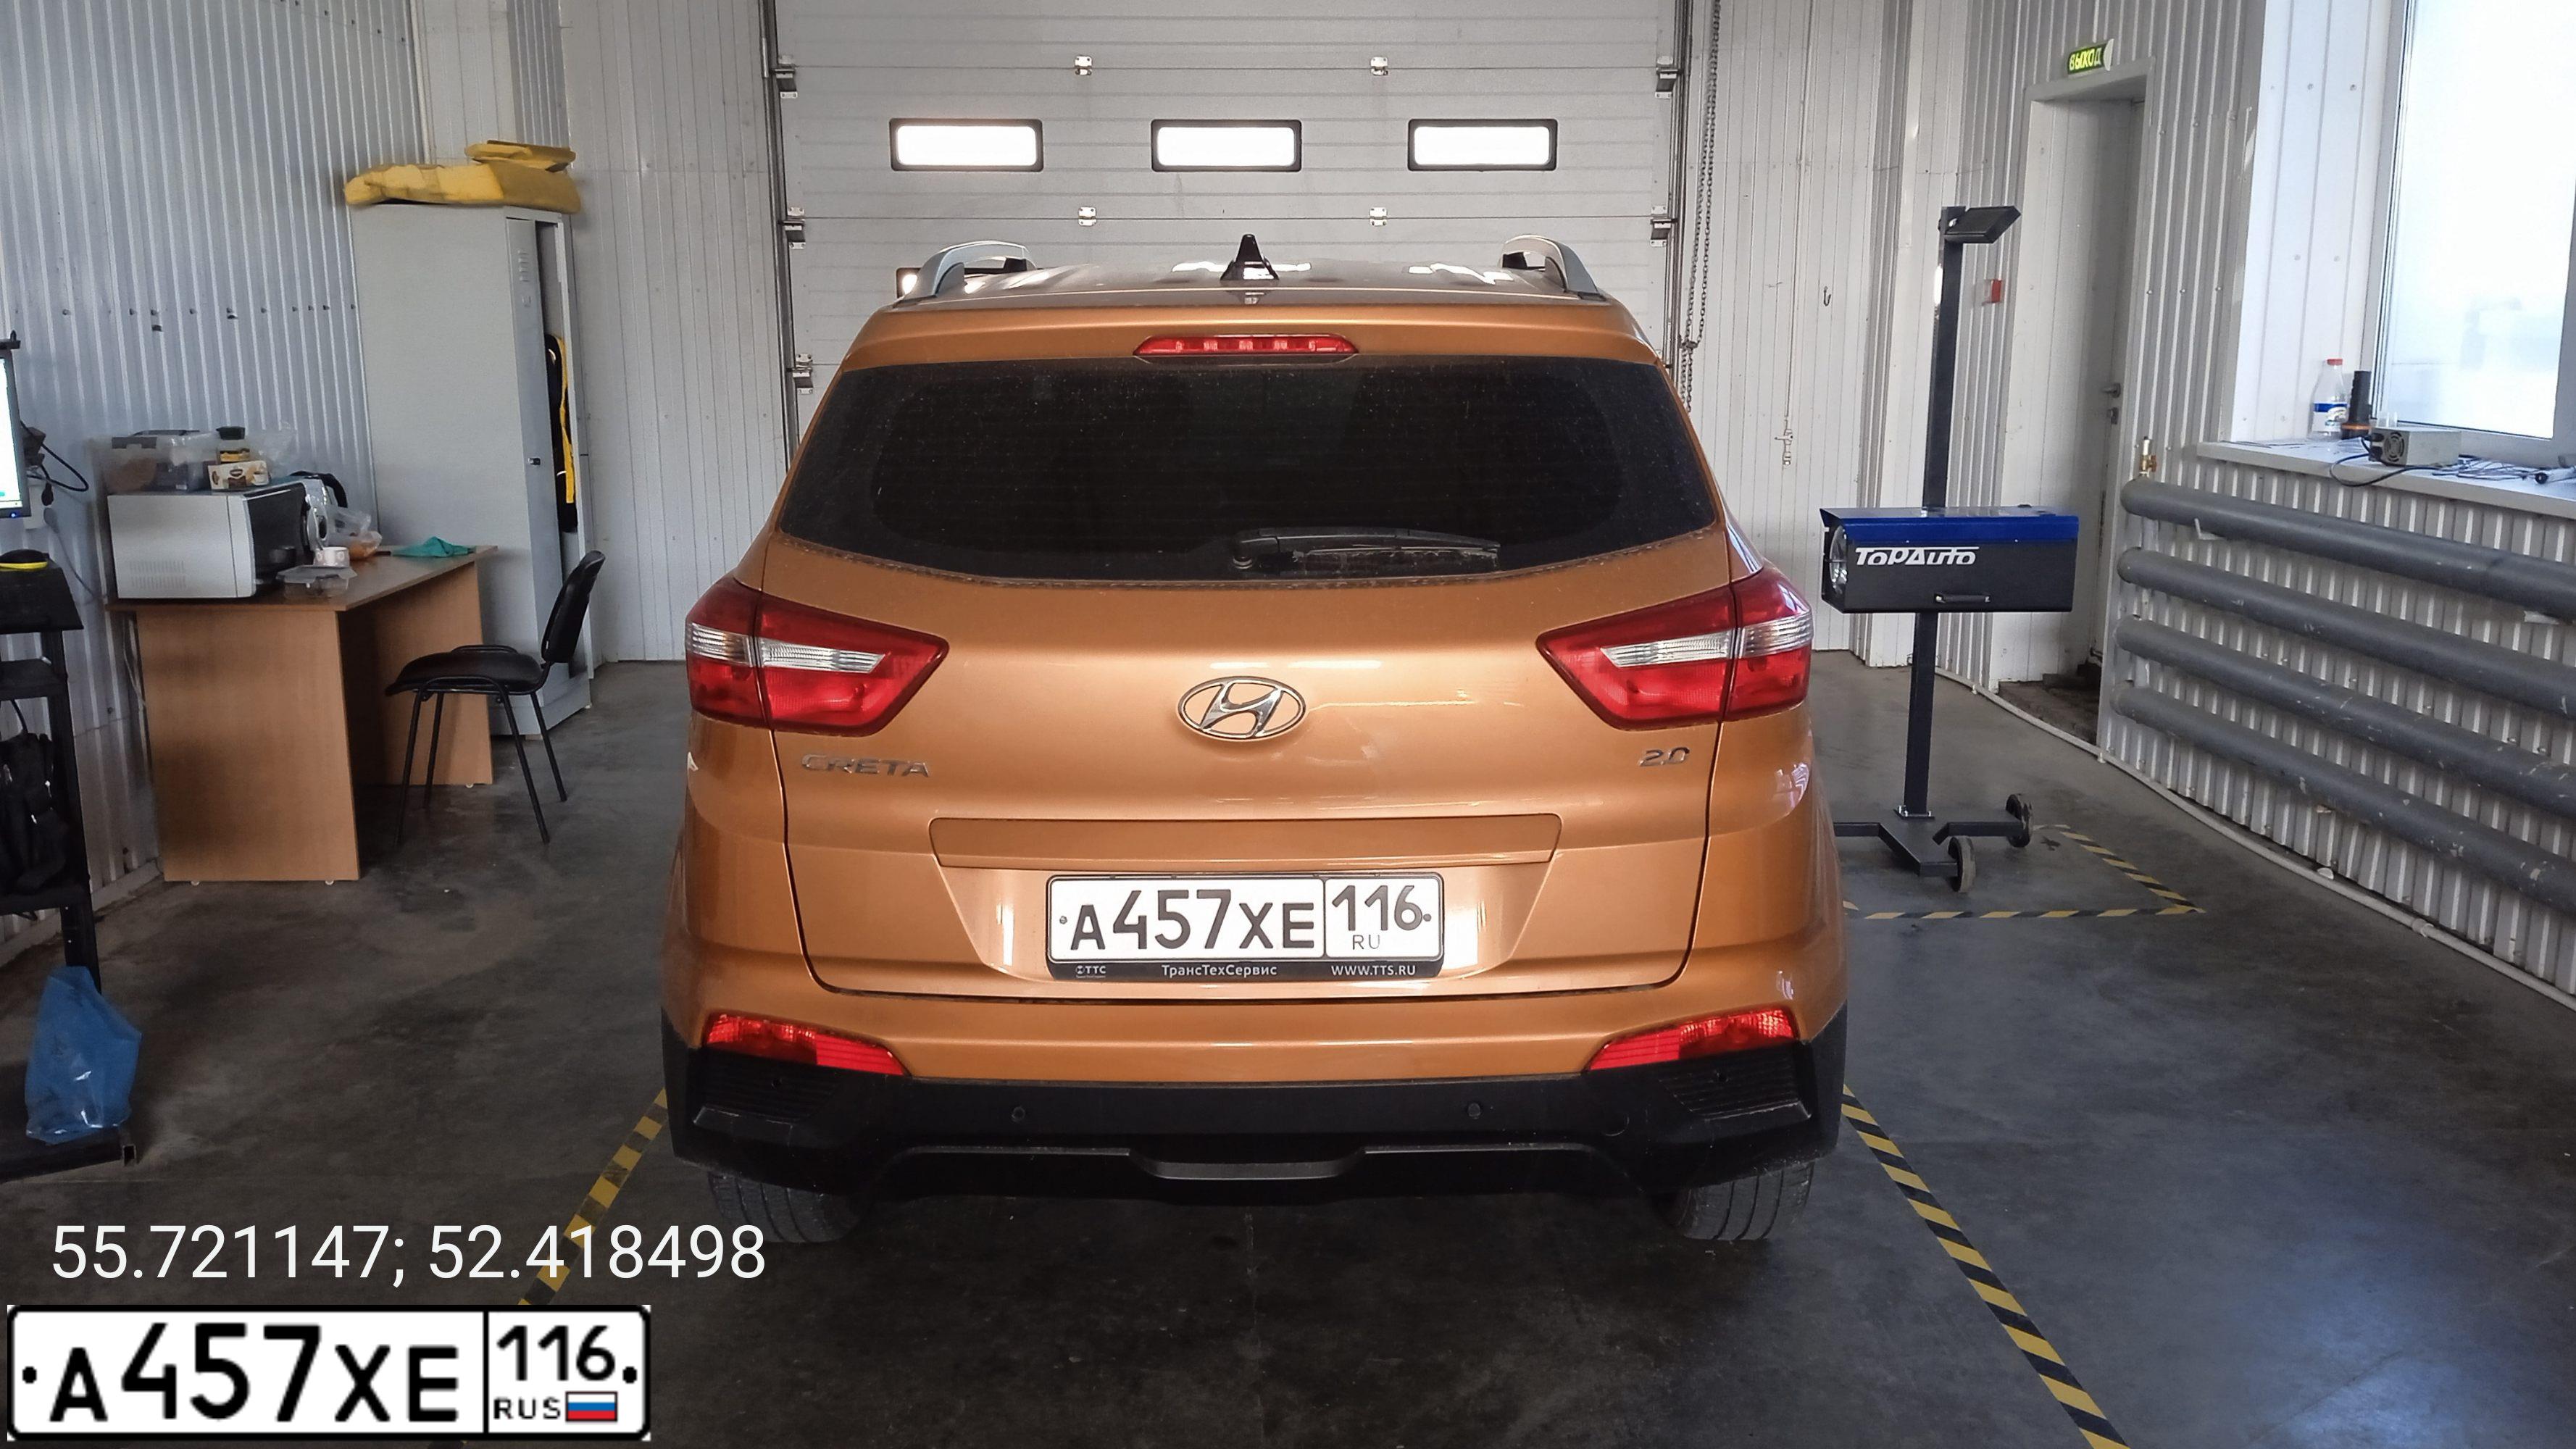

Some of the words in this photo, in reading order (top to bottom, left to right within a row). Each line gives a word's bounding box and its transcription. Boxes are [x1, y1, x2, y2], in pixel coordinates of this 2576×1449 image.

[2069, 47, 2101, 70] ВЫХОД
[802, 754, 928, 777] CRETA
[1332, 885, 1422, 931] 116
[1162, 964, 1277, 978] ТрансТехСервис
[1331, 965, 1416, 976] WWW.TTS.RU
